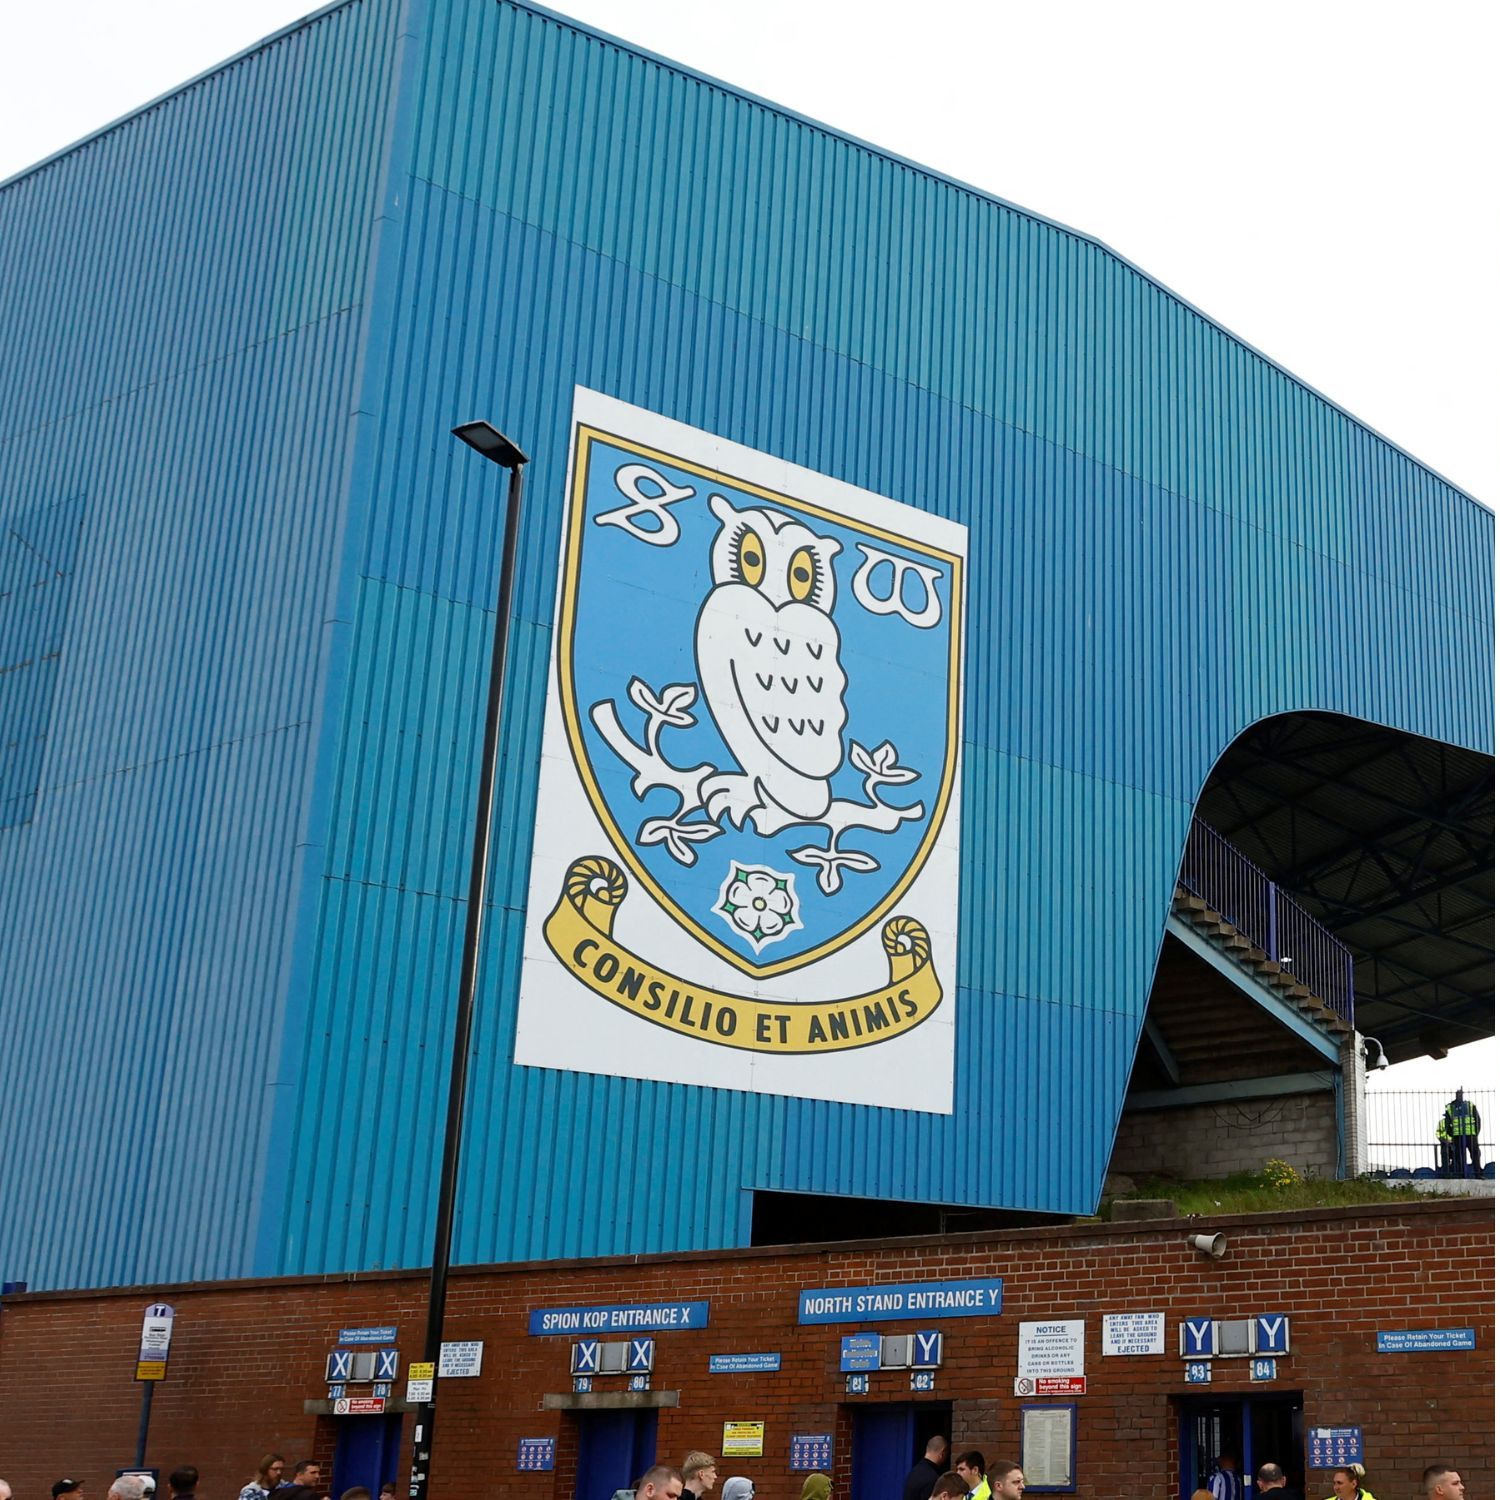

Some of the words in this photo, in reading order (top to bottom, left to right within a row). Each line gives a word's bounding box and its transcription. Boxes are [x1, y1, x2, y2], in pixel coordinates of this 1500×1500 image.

[573, 937, 738, 1038] CONSILIO
[756, 1014, 792, 1044] ET
[807, 989, 918, 1047] ANIMIS
[805, 1297, 852, 1315] NORTH
[856, 1294, 903, 1312] STAND
[907, 1289, 984, 1309] ENTRANCE
[988, 1289, 999, 1305] Y
[542, 1314, 580, 1330] SPION
[583, 1311, 608, 1328] KOP
[611, 1308, 678, 1326] ENTRANCE
[680, 1308, 690, 1323] X
[1036, 1326, 1066, 1334] NOTICE
[1187, 1321, 1209, 1350] Y
[1259, 1317, 1282, 1347] Y
[1414, 1340, 1451, 1348] Abandoned
[578, 1343, 596, 1368] X
[632, 1341, 649, 1366] X
[917, 1333, 937, 1361] Y
[1117, 1345, 1150, 1353] EJECTED
[332, 1352, 349, 1376] X
[378, 1351, 395, 1375] X
[1256, 1362, 1270, 1377] 84
[578, 1378, 587, 1390] 79
[634, 1377, 644, 1389] 80
